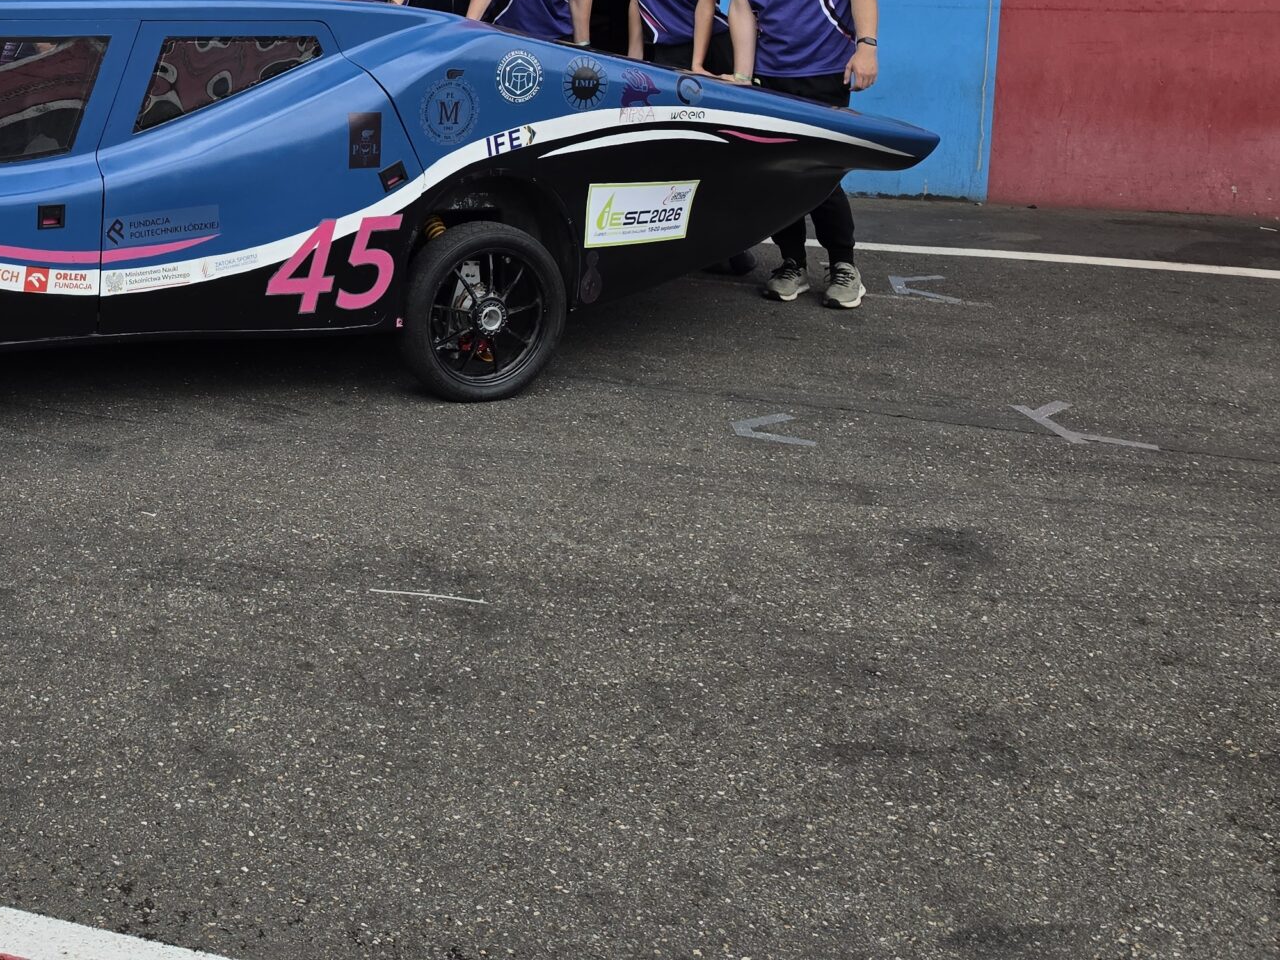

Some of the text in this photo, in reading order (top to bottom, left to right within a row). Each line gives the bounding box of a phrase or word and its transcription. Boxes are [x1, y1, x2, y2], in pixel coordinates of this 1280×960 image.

[575, 79, 597, 88] IMP
[438, 100, 461, 125] M
[486, 128, 522, 157] IFE
[129, 217, 171, 229] FUNDACJA
[129, 225, 182, 240] POLITECHNIKI
[265, 214, 404, 315] 45
[55, 272, 87, 282] ORLEN
[125, 267, 161, 278] Ministerstwo
[54, 281, 93, 291] FUNDACJA
[128, 275, 161, 286] Szkolnictwa
